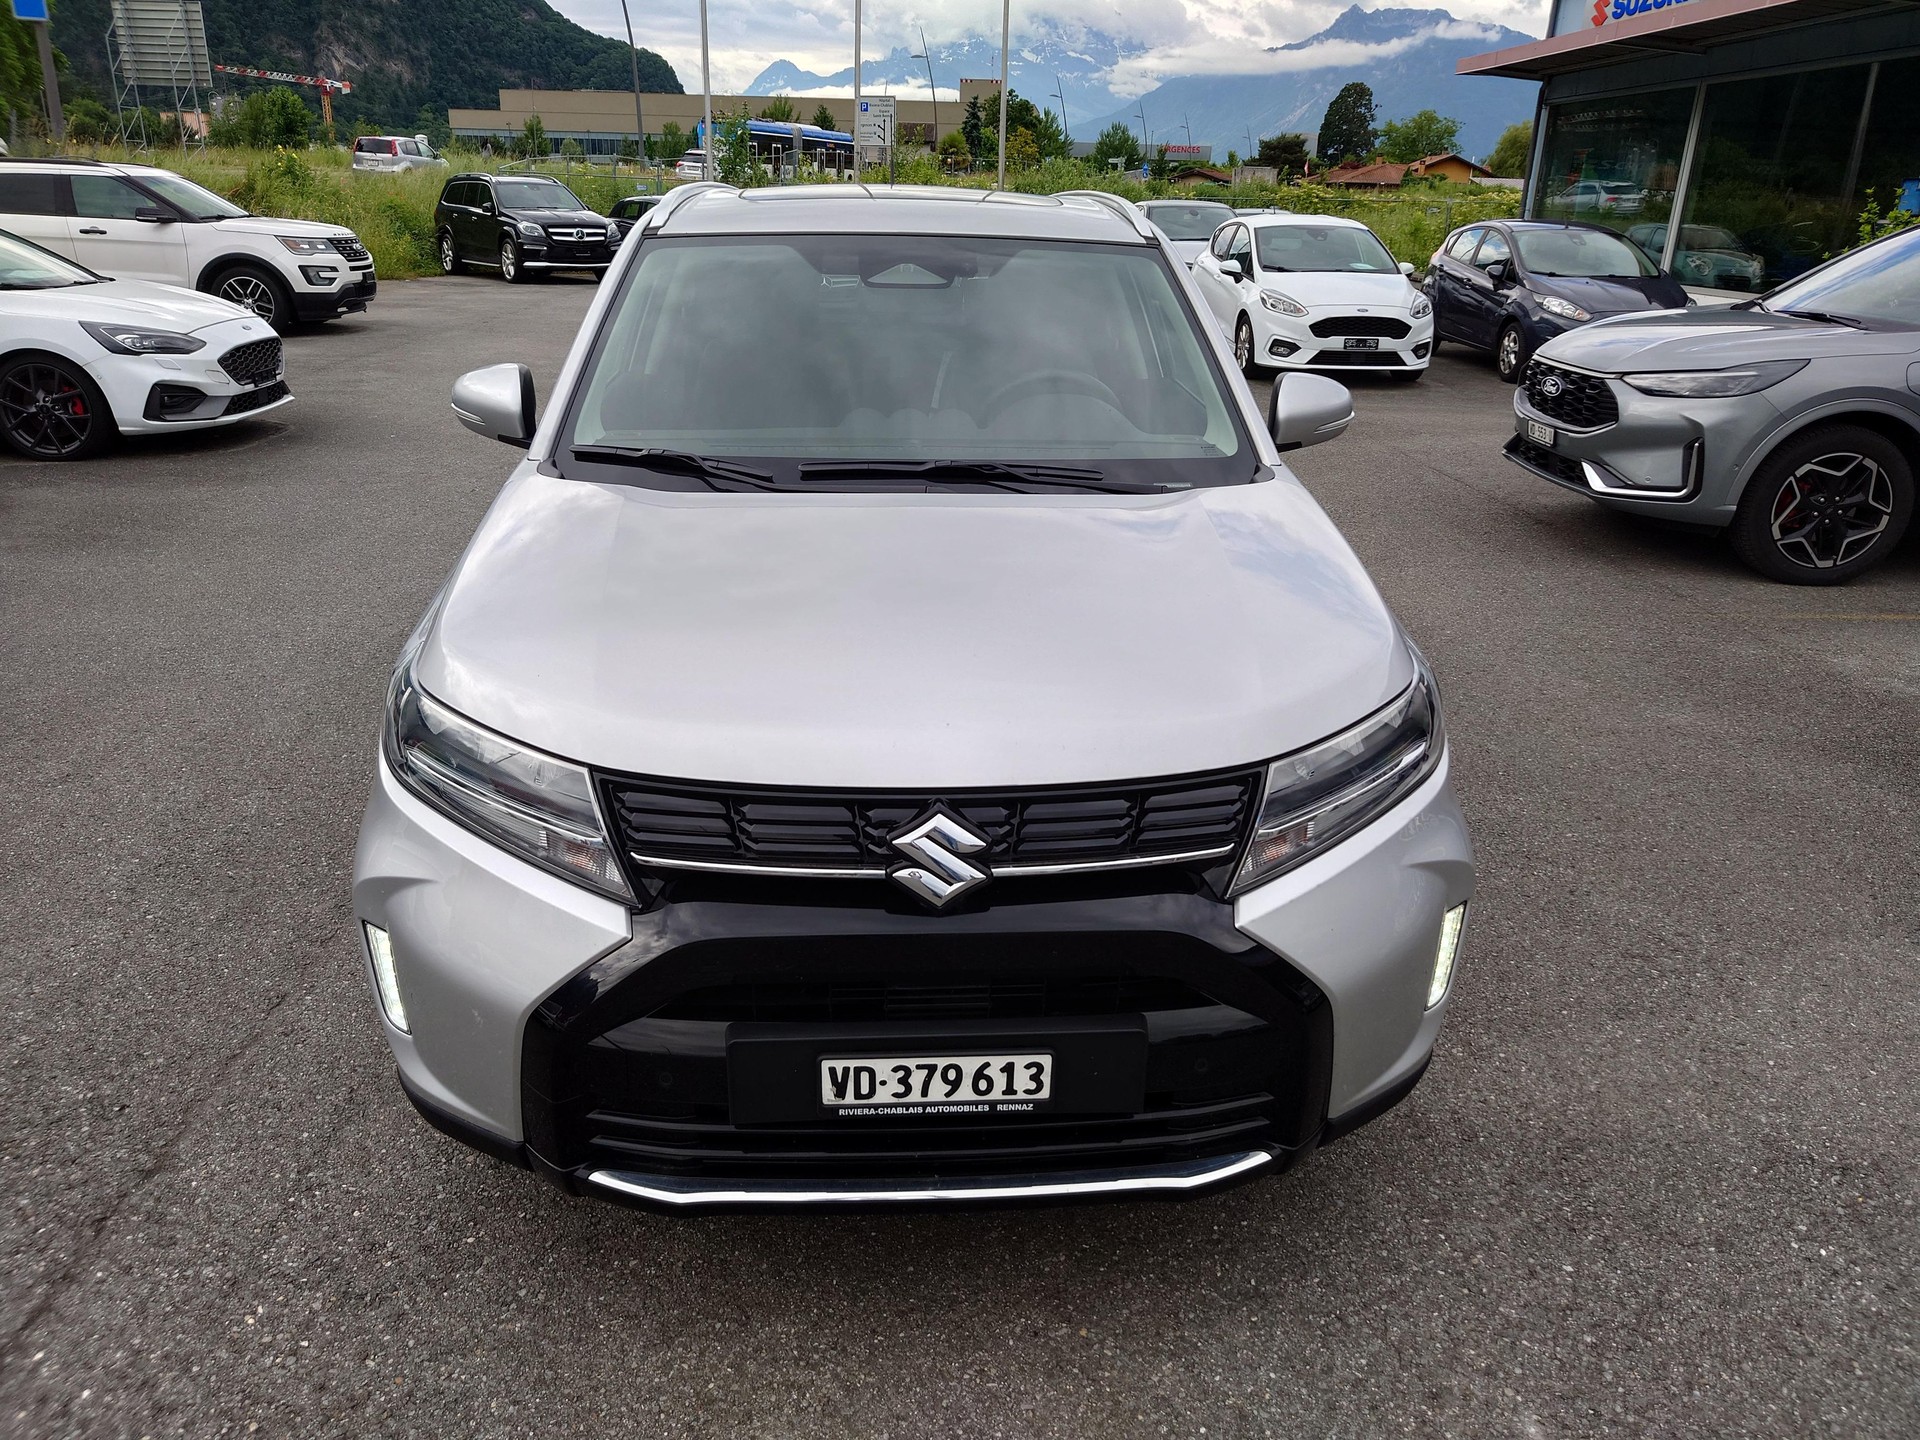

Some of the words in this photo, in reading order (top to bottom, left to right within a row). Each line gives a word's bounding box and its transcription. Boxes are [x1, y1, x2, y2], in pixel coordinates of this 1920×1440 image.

[1612, 0, 1690, 20] SUZU
[1163, 145, 1201, 153] RGENCES
[839, 1106, 923, 1116] RIVIERA-CHABLAIS
[925, 1104, 989, 1113] AUTOMOBILES
[997, 1103, 1033, 1111] RENNAZ
